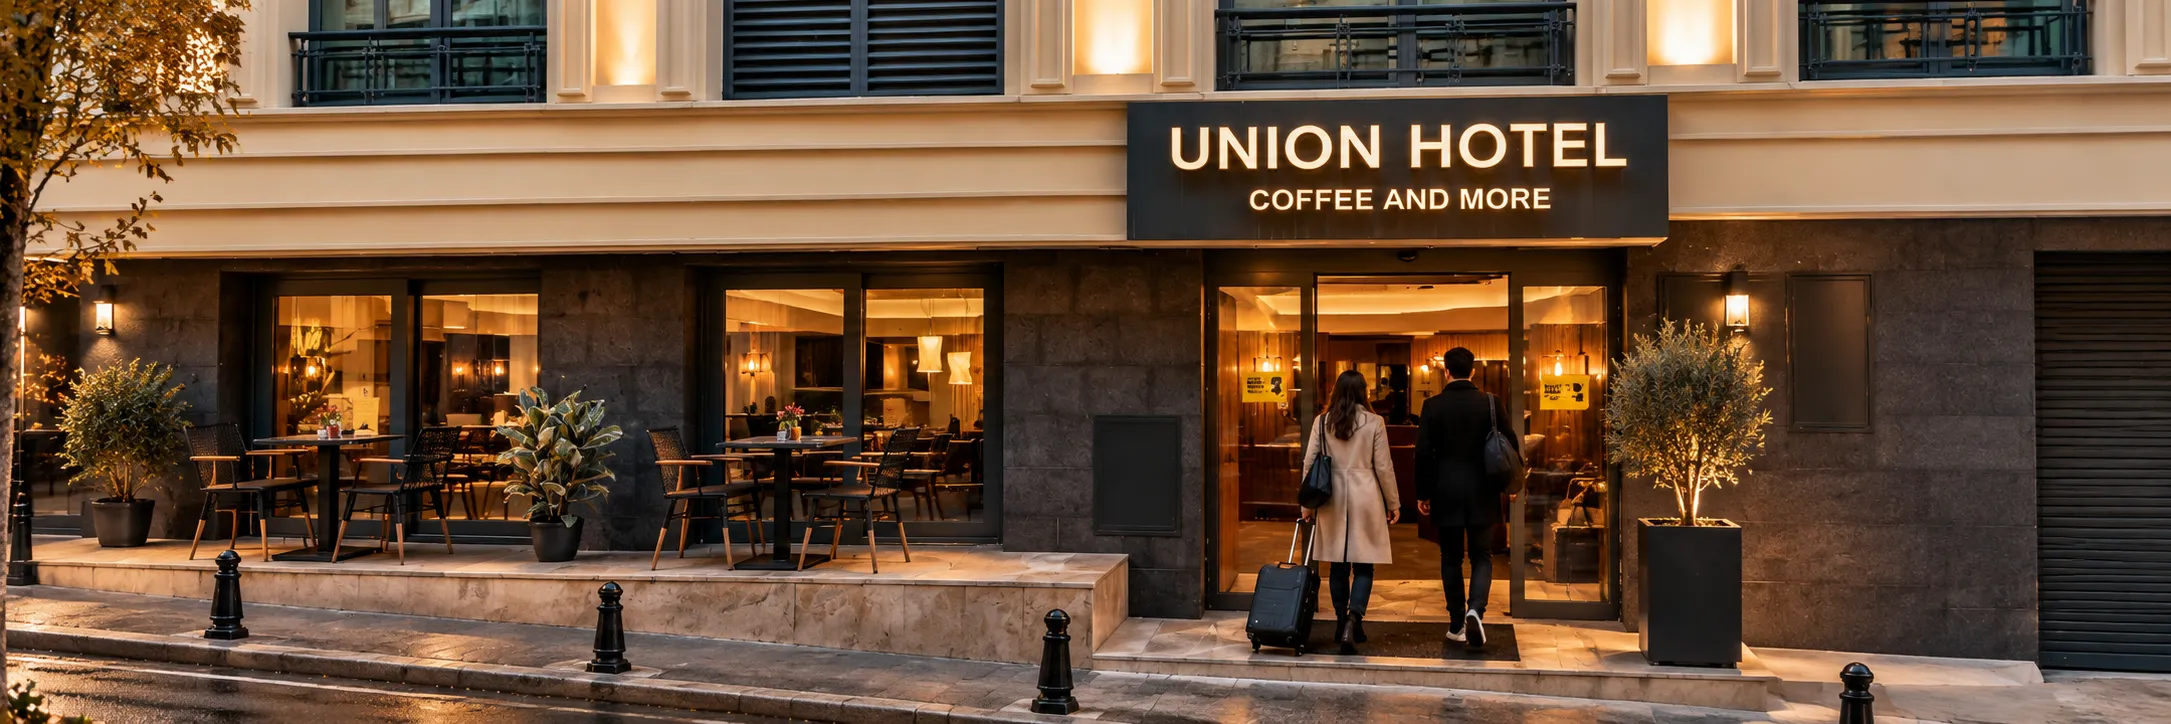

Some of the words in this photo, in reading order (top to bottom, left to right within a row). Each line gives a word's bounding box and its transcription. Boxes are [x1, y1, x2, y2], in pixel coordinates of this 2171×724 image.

[1171, 125, 1380, 170] UNION
[1410, 122, 1627, 169] HOTEL
[1249, 189, 1374, 211] COFFEE
[1383, 188, 1449, 210] AND
[1460, 187, 1551, 210] MORE
